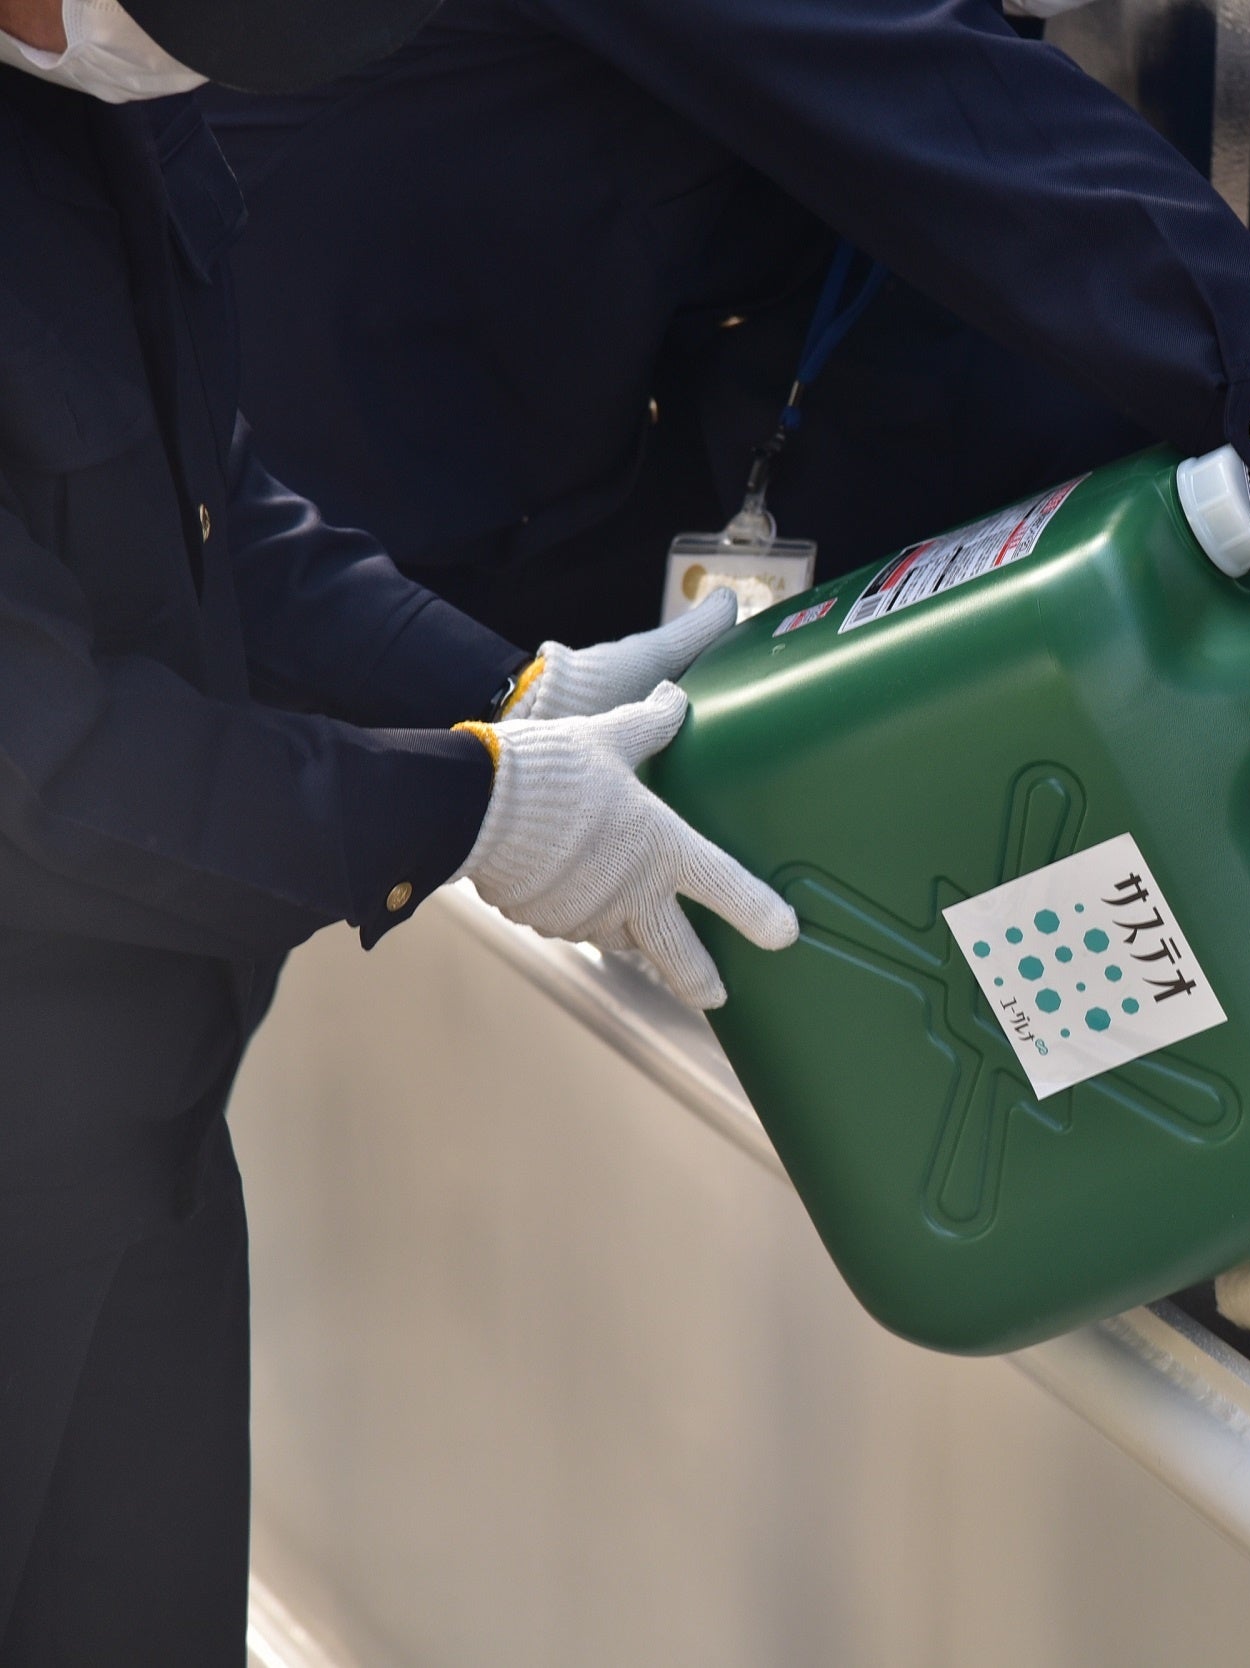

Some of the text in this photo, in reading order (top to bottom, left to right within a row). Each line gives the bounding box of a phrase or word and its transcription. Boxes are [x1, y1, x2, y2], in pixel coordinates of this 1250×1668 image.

[1101, 872, 1197, 1002] サステオ
[1000, 997, 1035, 1042] ユーグレナ
